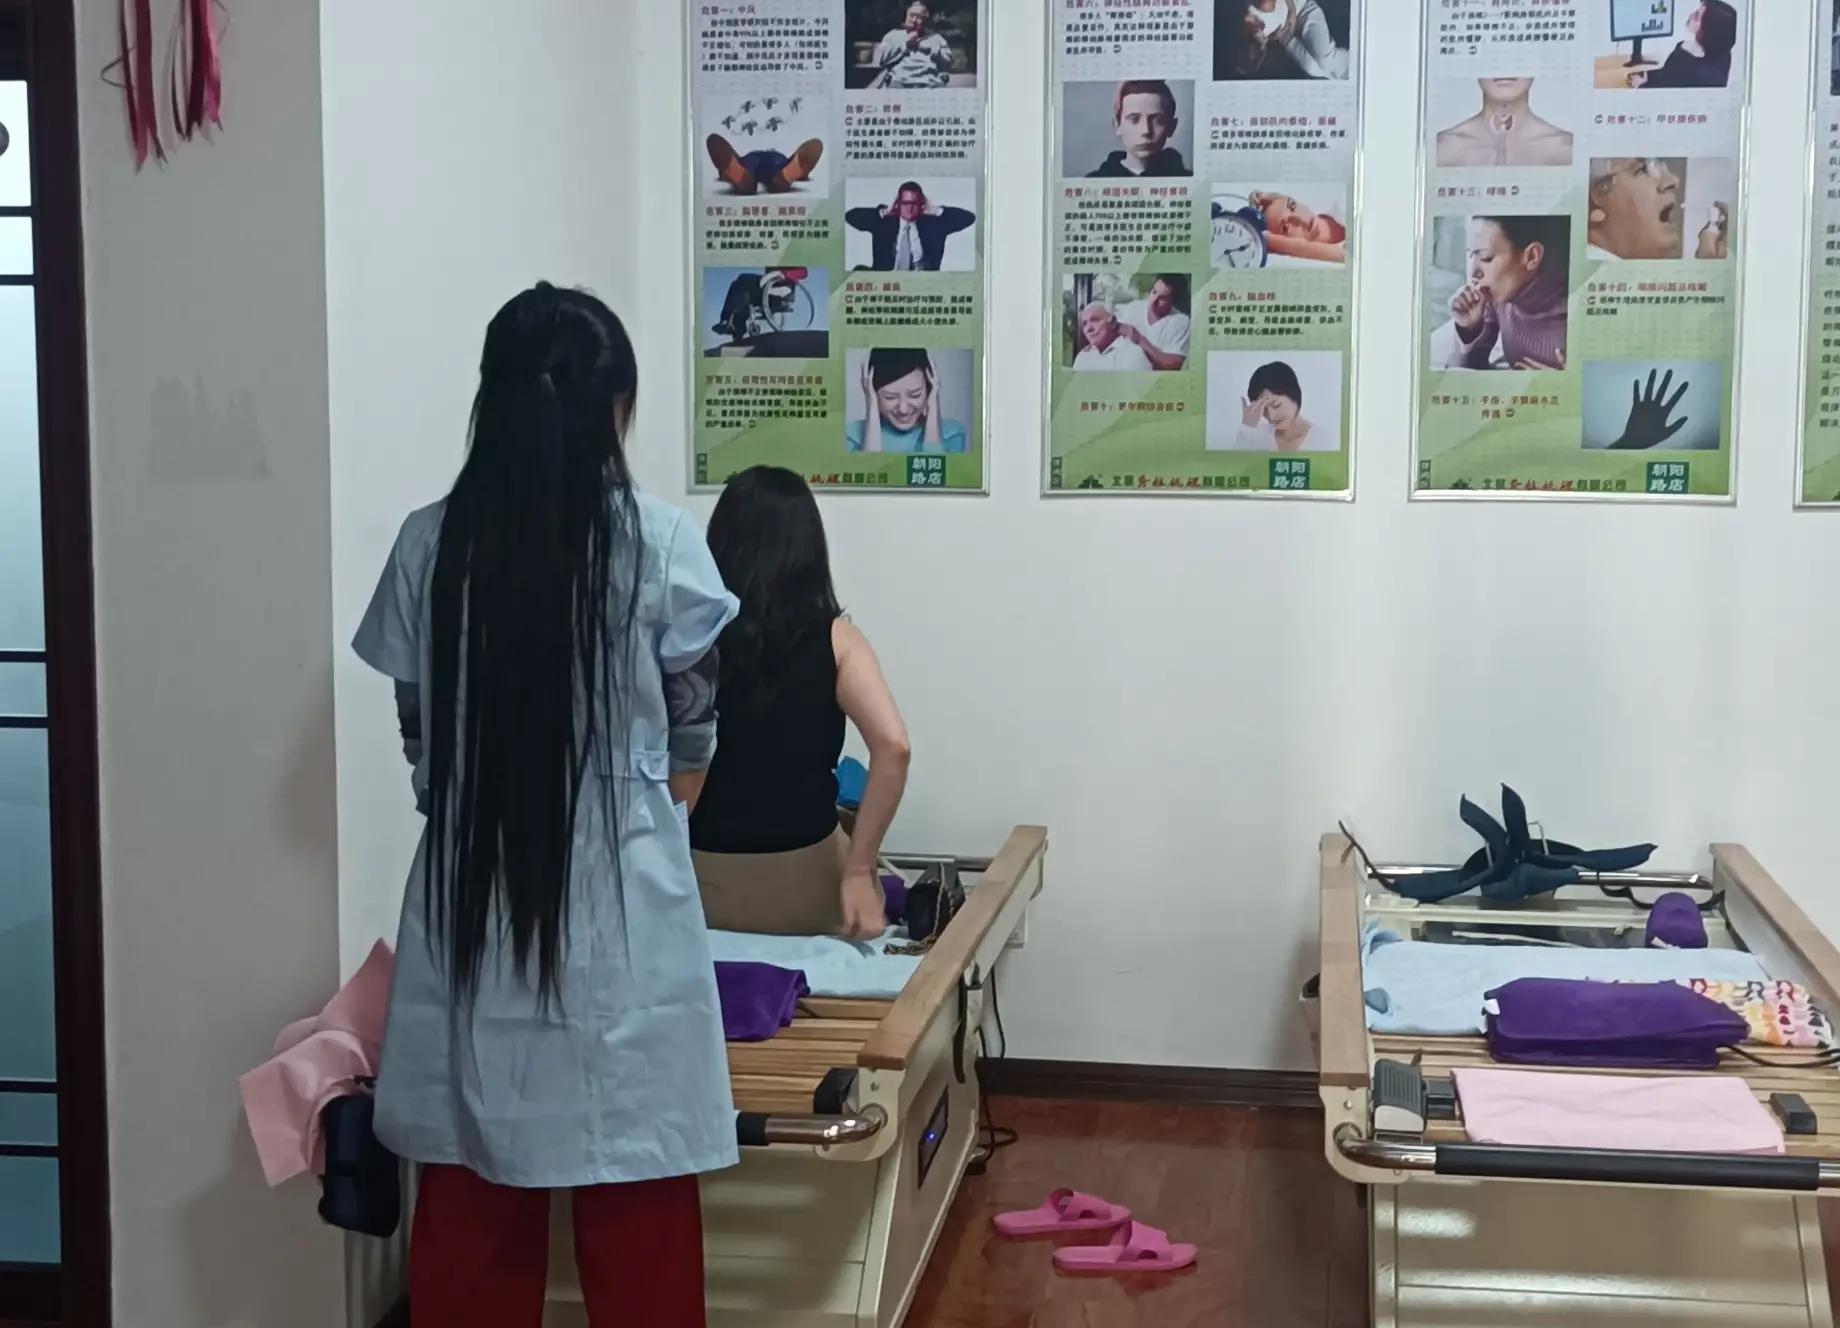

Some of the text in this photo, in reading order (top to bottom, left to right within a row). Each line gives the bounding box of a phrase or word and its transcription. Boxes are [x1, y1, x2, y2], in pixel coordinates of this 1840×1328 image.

[911, 457, 942, 470] 朝阳
[1274, 460, 1306, 473] 朝阳
[1652, 463, 1685, 477] 朝阳
[911, 472, 942, 485] 路店
[1273, 475, 1306, 489] 路店
[1650, 478, 1685, 492] 路店
